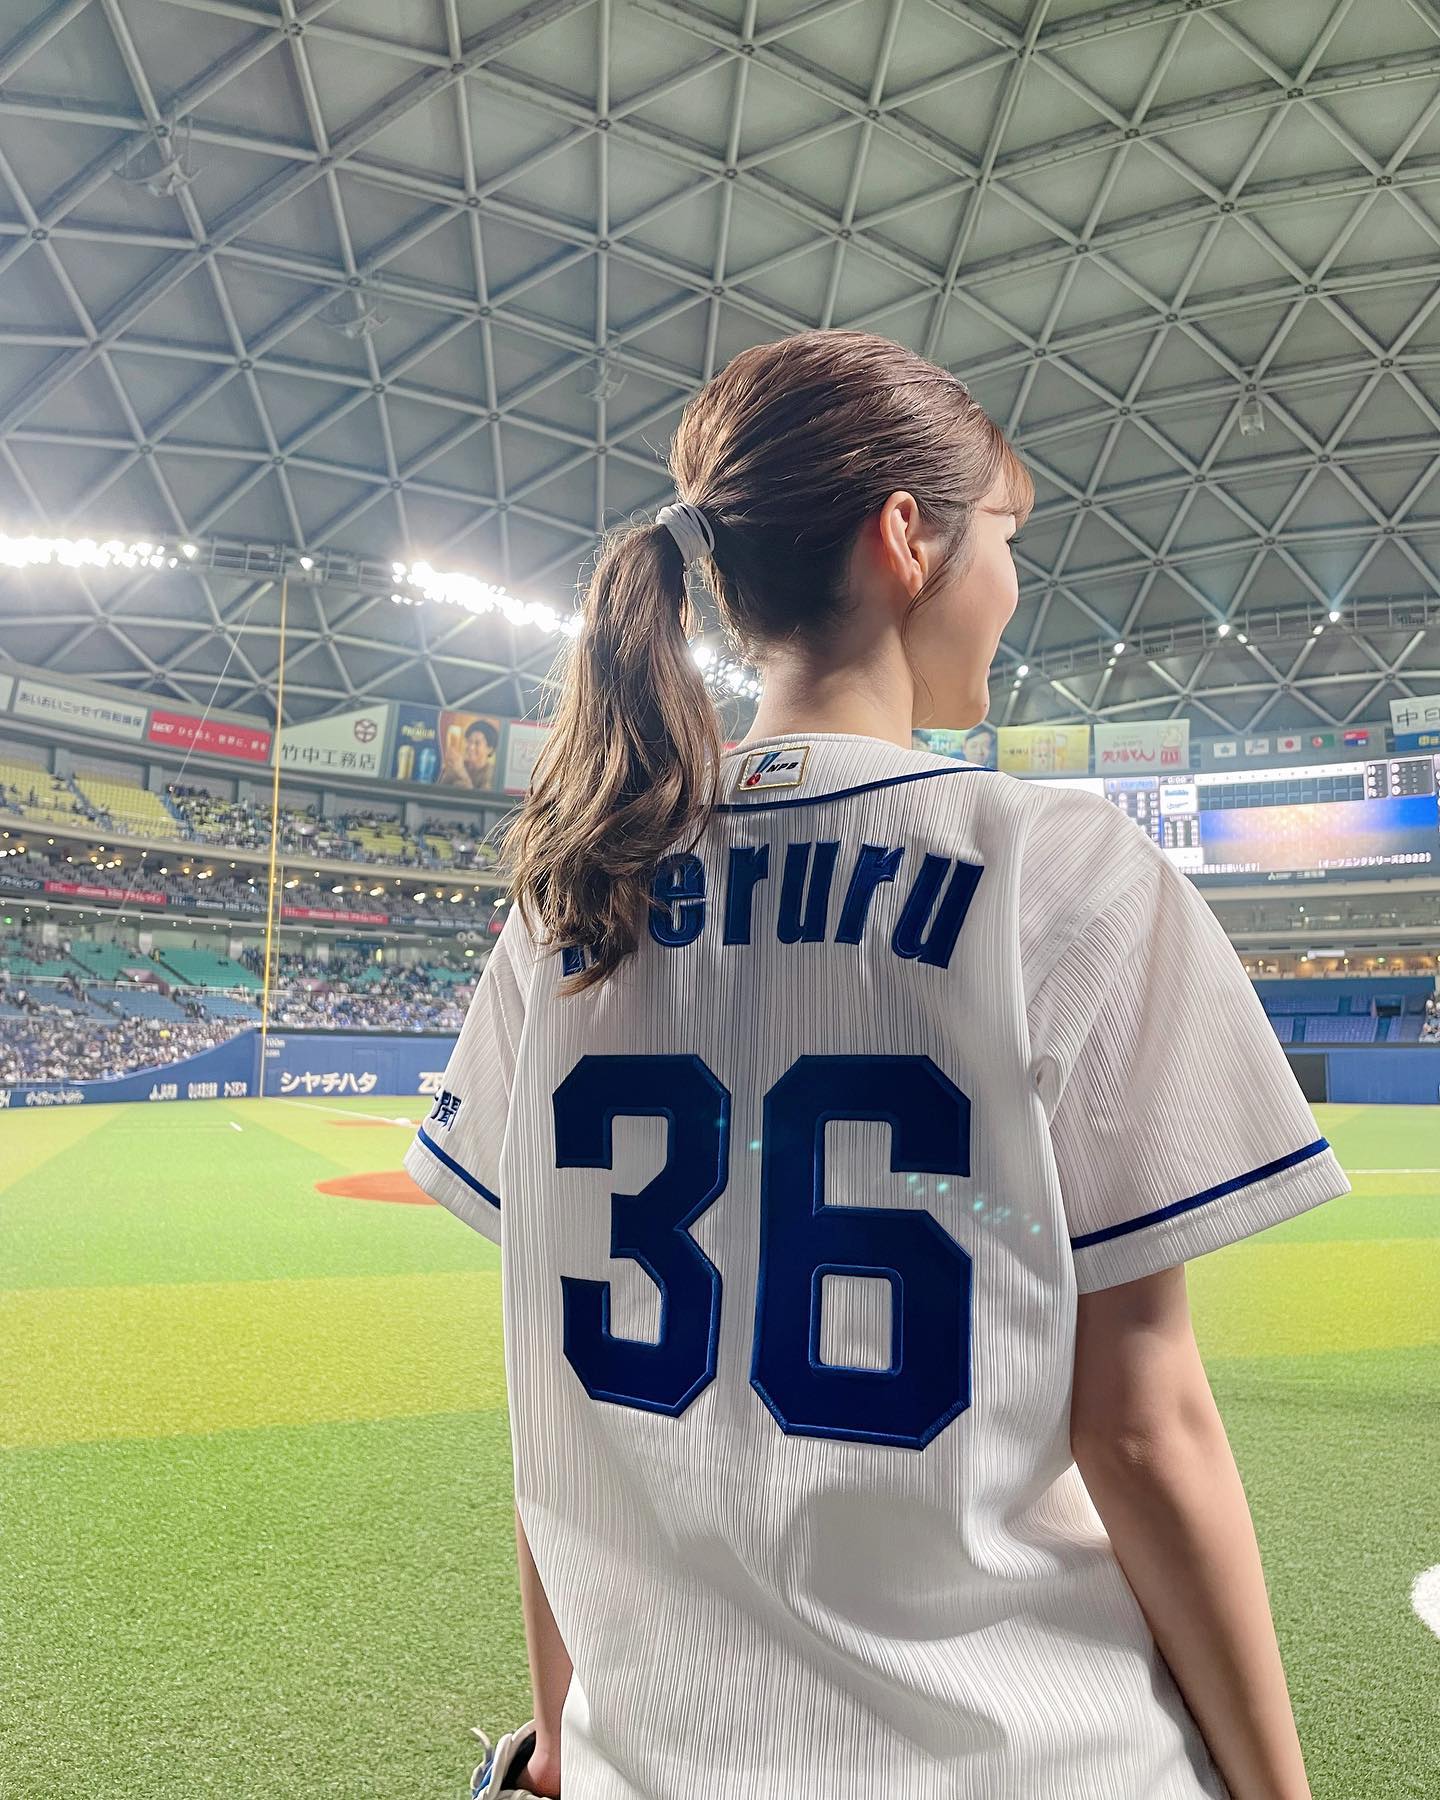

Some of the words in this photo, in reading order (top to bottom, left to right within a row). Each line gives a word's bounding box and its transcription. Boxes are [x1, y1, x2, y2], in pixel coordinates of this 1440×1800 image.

[281, 744, 376, 770] 竹中工務店
[766, 761, 799, 773] NPB
[562, 841, 985, 977] eruru
[280, 1071, 378, 1093] シヤチハタ
[552, 1054, 973, 1452] 36
